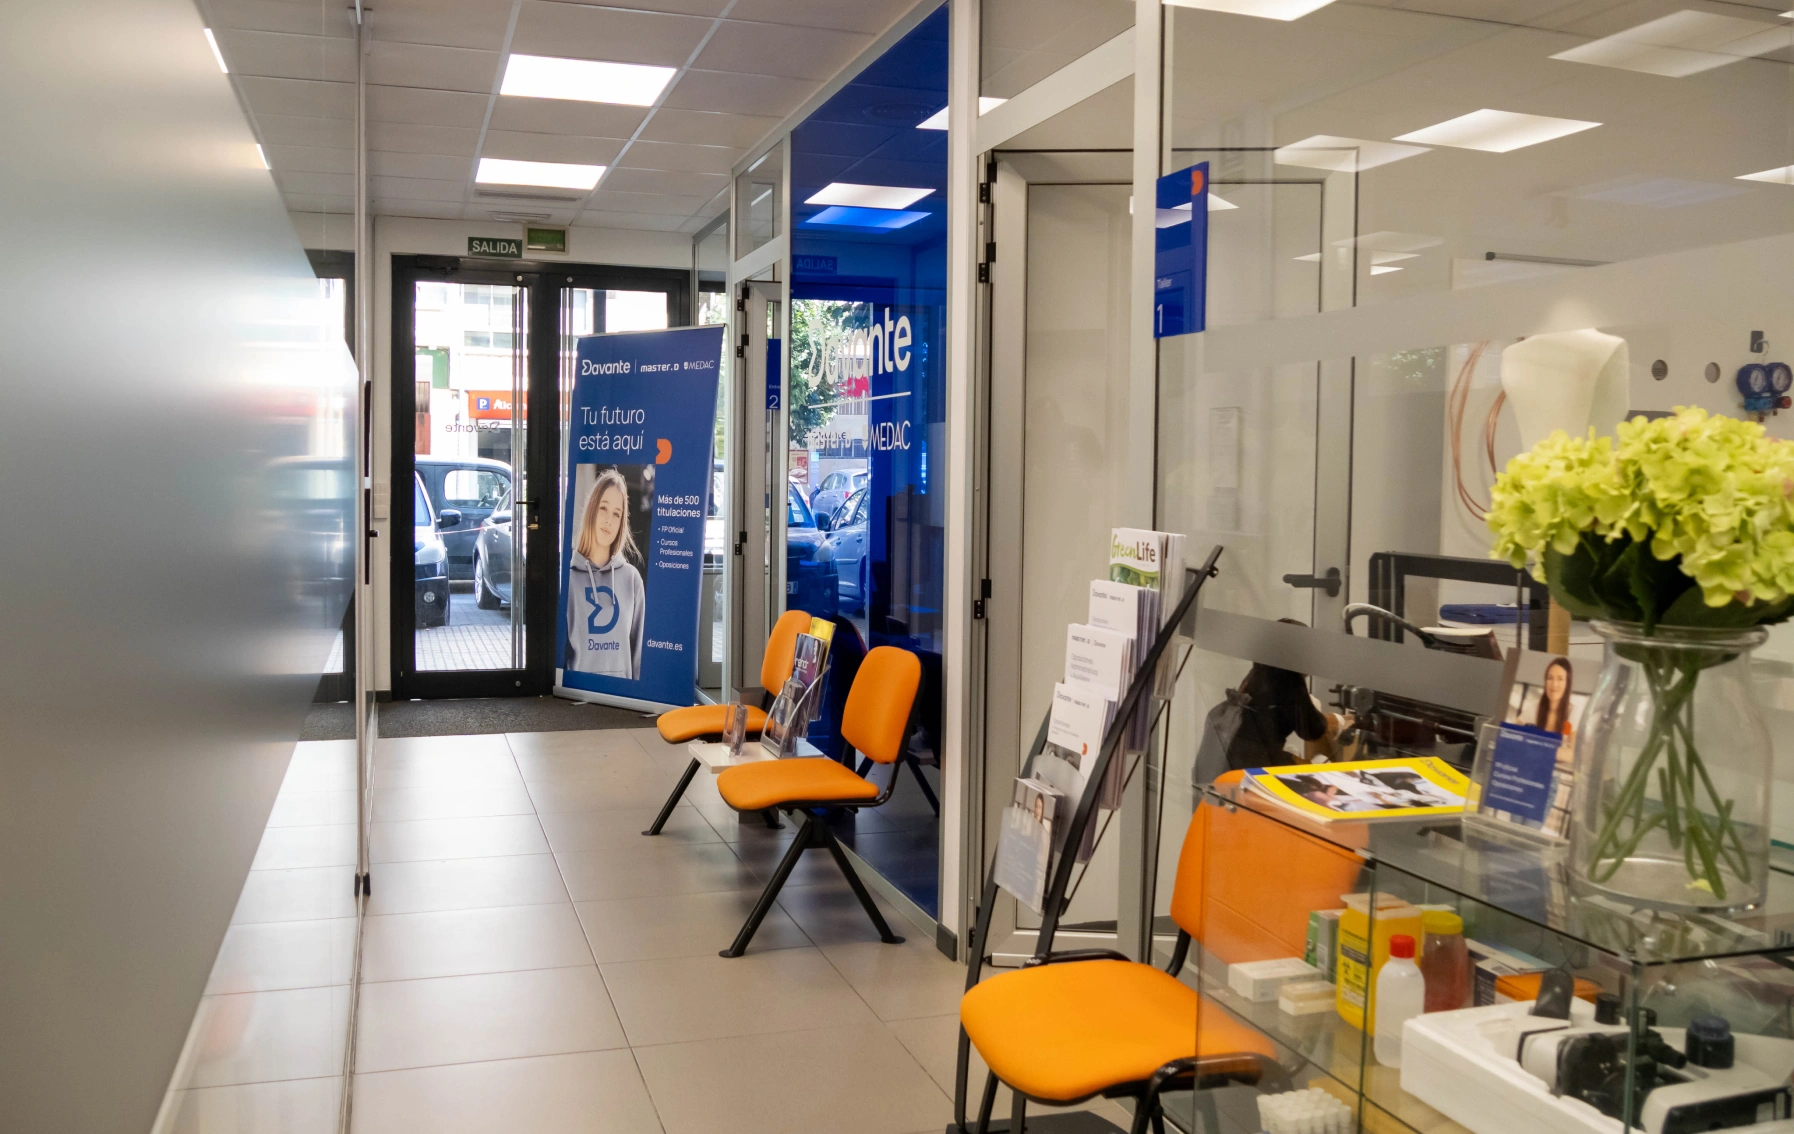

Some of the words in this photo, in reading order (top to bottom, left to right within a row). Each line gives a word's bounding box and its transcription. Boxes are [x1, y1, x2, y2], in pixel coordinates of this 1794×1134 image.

[472, 240, 518, 254] SALIDA
[1157, 278, 1172, 289] Taller
[1157, 303, 1163, 334] 1
[808, 307, 912, 388] Davante
[581, 359, 631, 376] Davante
[688, 360, 715, 370] MEDAC
[769, 394, 779, 409] 2
[580, 406, 598, 425] Tu
[601, 405, 645, 425] futuro
[871, 420, 911, 451] MEDAC
[579, 430, 610, 450] está
[612, 429, 645, 456] aquí
[658, 494, 673, 504] Más
[674, 495, 683, 505] de
[685, 495, 700, 505] 500
[657, 507, 701, 518] titulaciones
[661, 525, 668, 533] FP
[660, 538, 679, 546] Cursos
[660, 547, 694, 557] Profesionales
[658, 560, 690, 569] Oposiciones
[588, 639, 620, 651] Davante
[646, 639, 683, 651] davante.es
